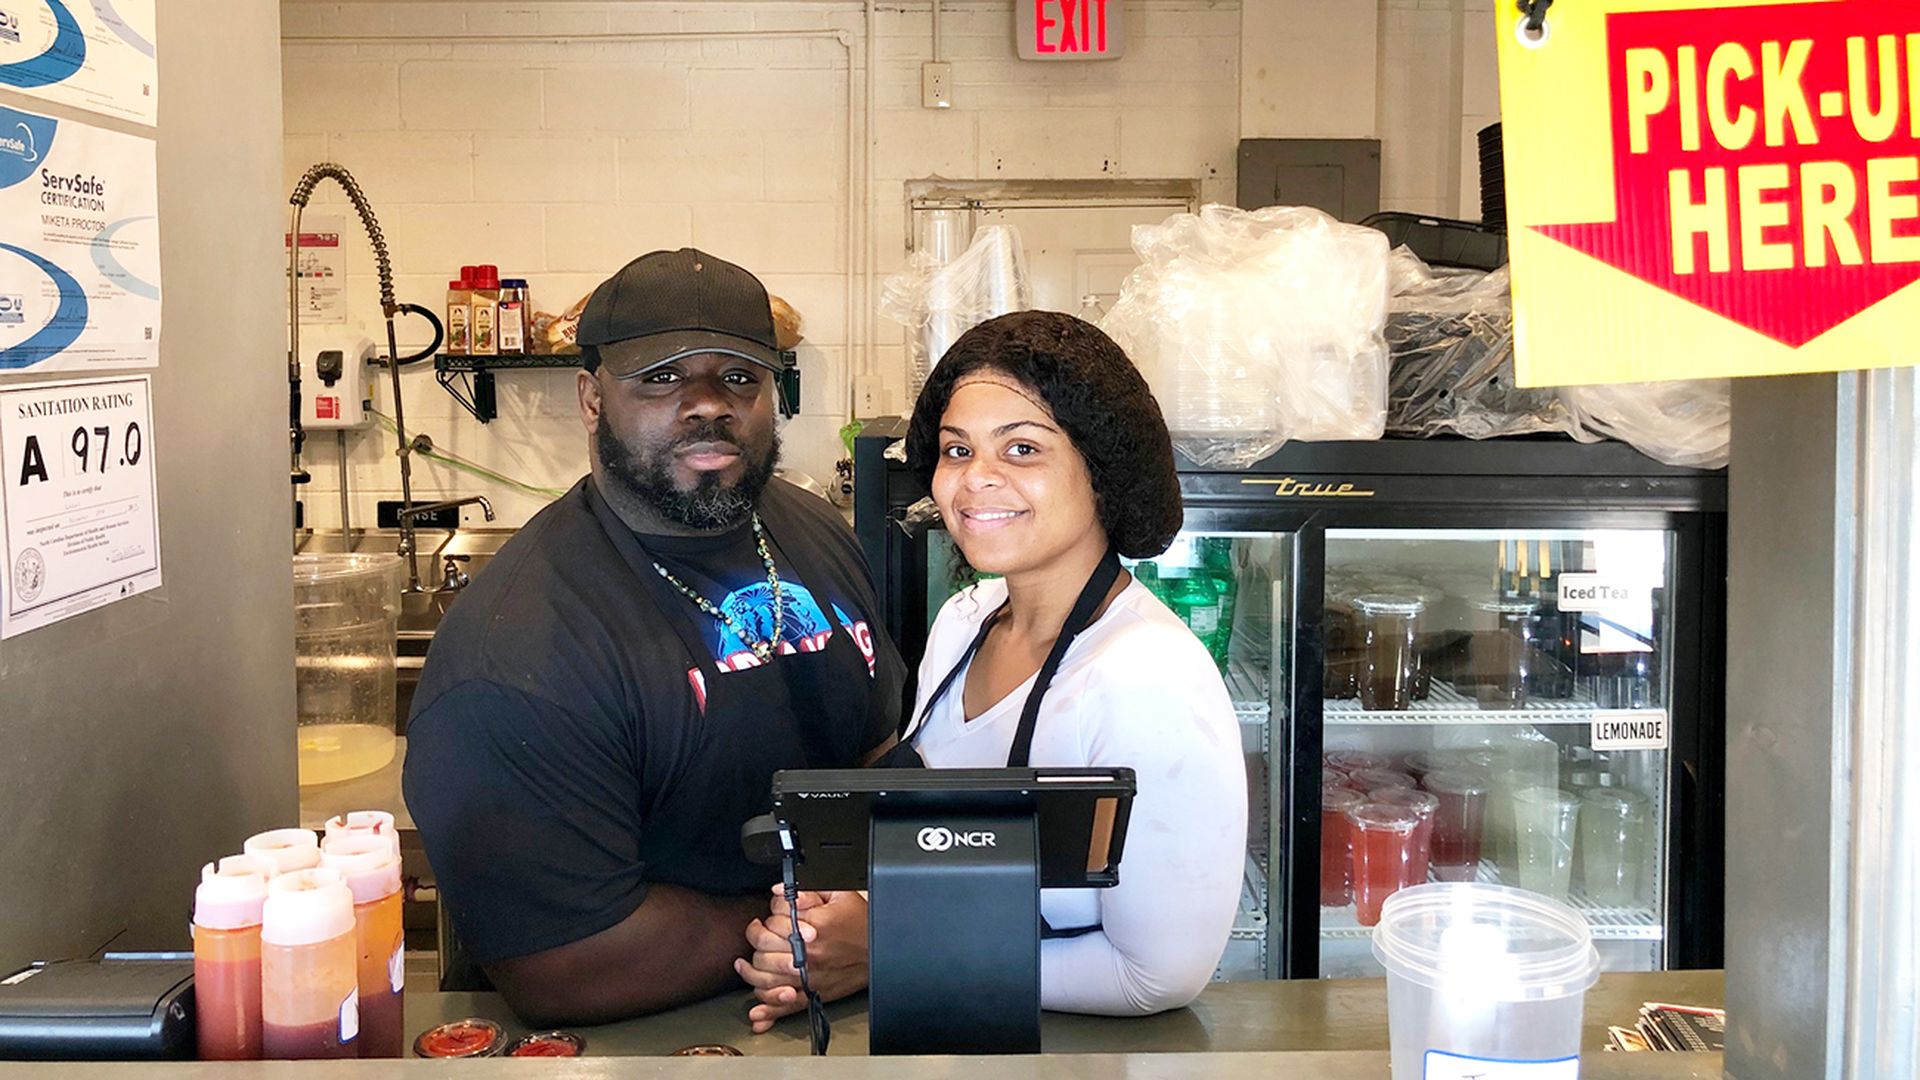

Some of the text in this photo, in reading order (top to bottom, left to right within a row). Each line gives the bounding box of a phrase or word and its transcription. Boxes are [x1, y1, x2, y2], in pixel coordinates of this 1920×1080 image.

[1035, 0, 1106, 53] EXIT
[41, 168, 104, 196] ServSafe
[41, 191, 105, 212] CERTIFICATION
[71, 217, 106, 231] PROCTOR
[1668, 157, 1920, 275] HERE
[18, 392, 133, 419] SANITATION RATING
[20, 435, 49, 486] A
[1241, 477, 1375, 496] true
[396, 508, 439, 521] RNSE
[1563, 585, 1629, 600] Iced Tea
[1596, 721, 1663, 741] LEMONADE
[954, 831, 996, 847] NCR
